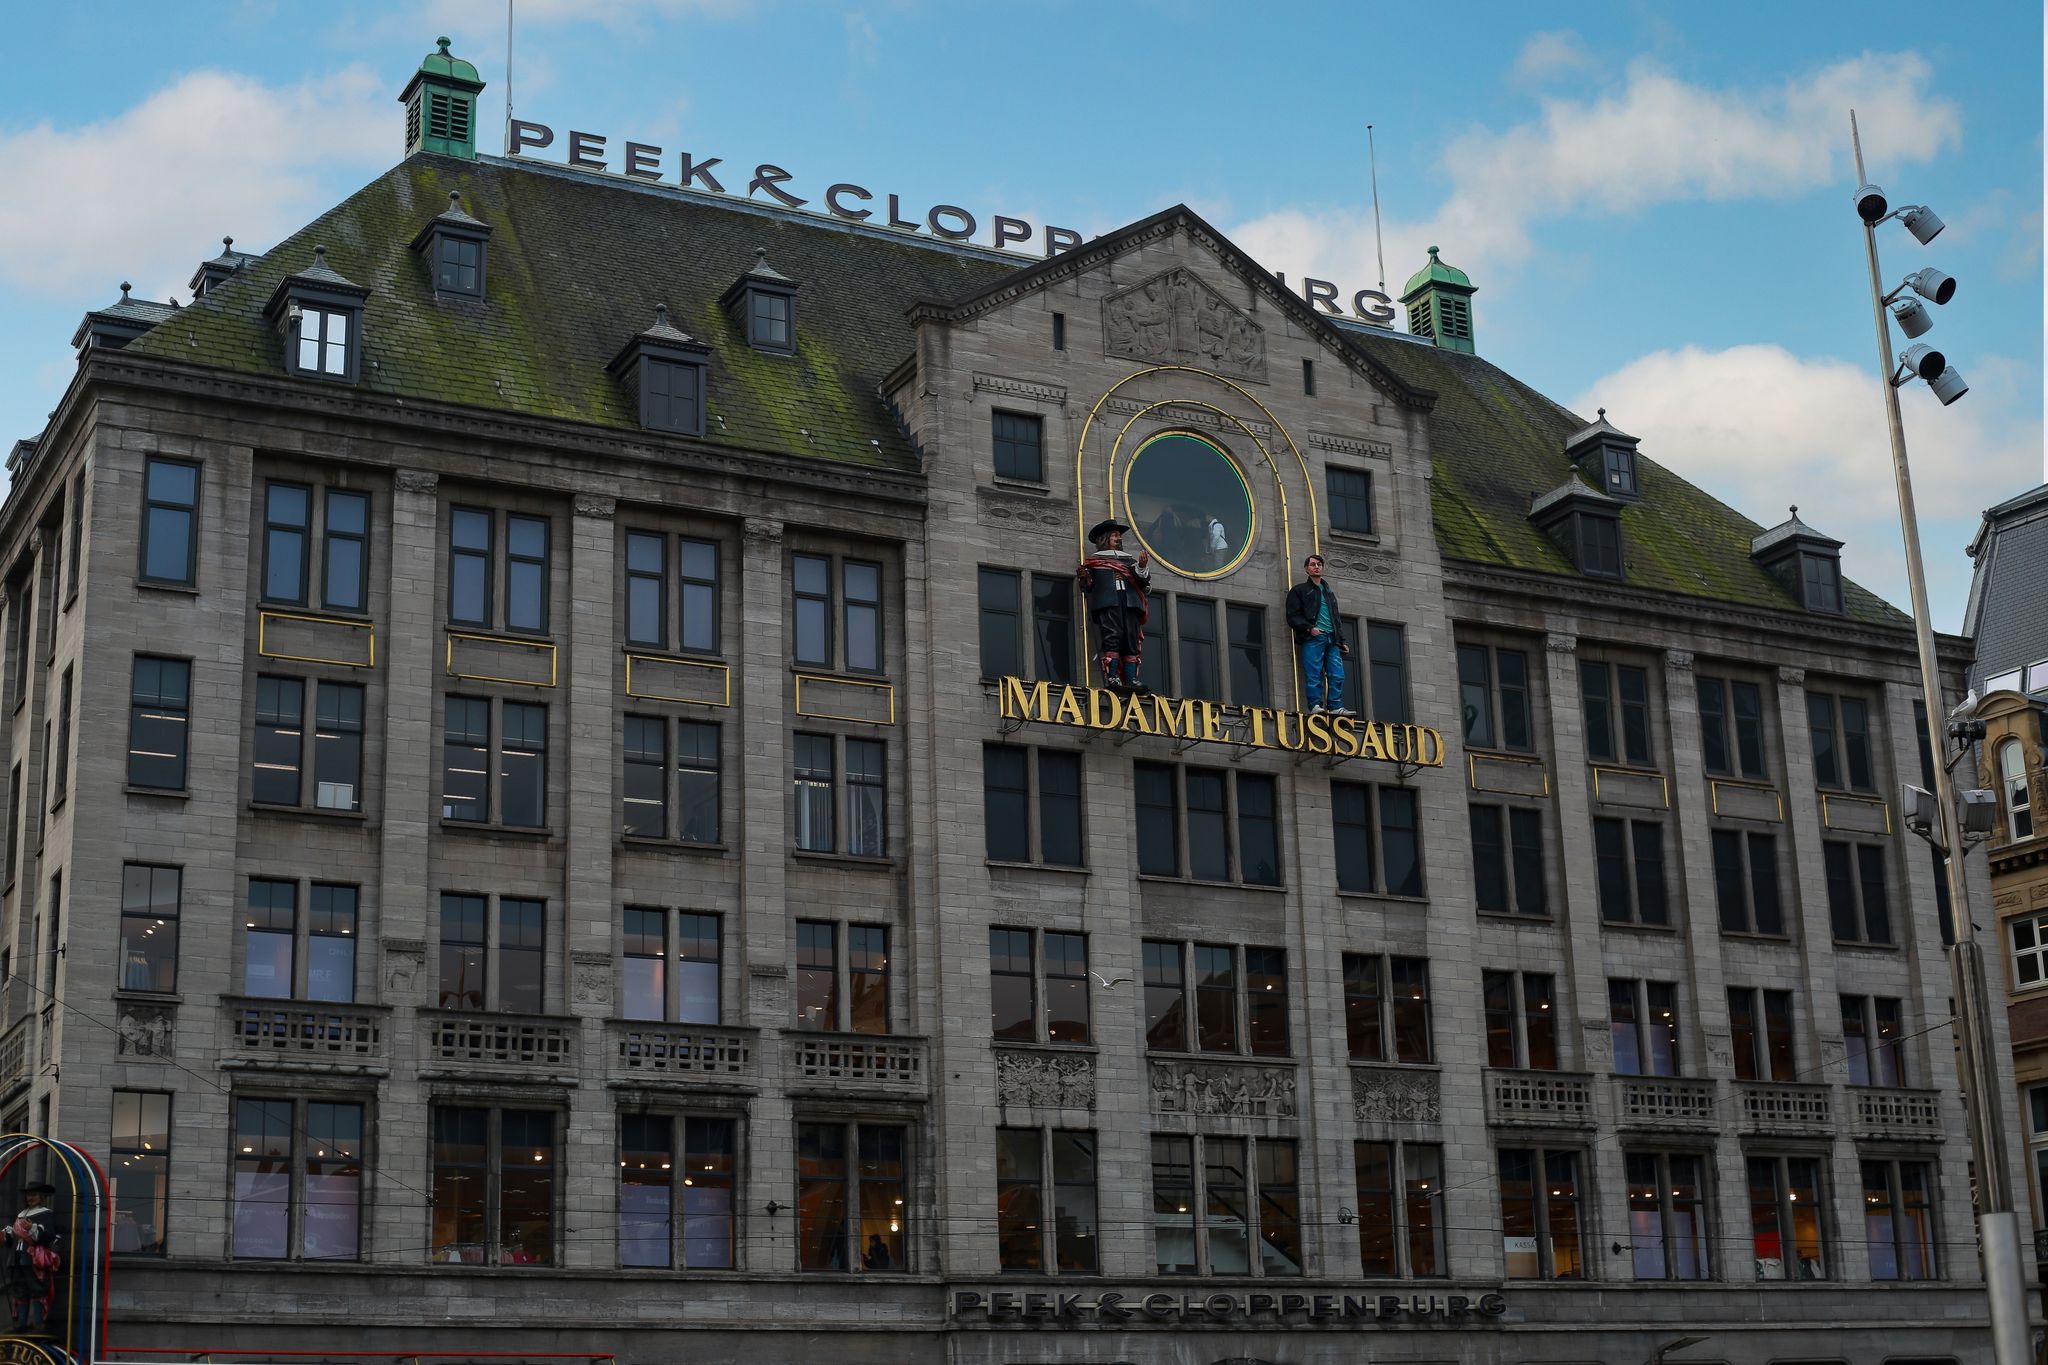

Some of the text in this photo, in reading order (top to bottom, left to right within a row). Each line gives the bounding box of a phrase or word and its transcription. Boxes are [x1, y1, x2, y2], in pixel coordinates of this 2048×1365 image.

[510, 118, 726, 193] PEEK
[749, 163, 808, 208] &
[1000, 675, 1445, 768] MADAME TUSSAUD
[951, 1291, 1508, 1320] PEEK & CLOPPENBURG
